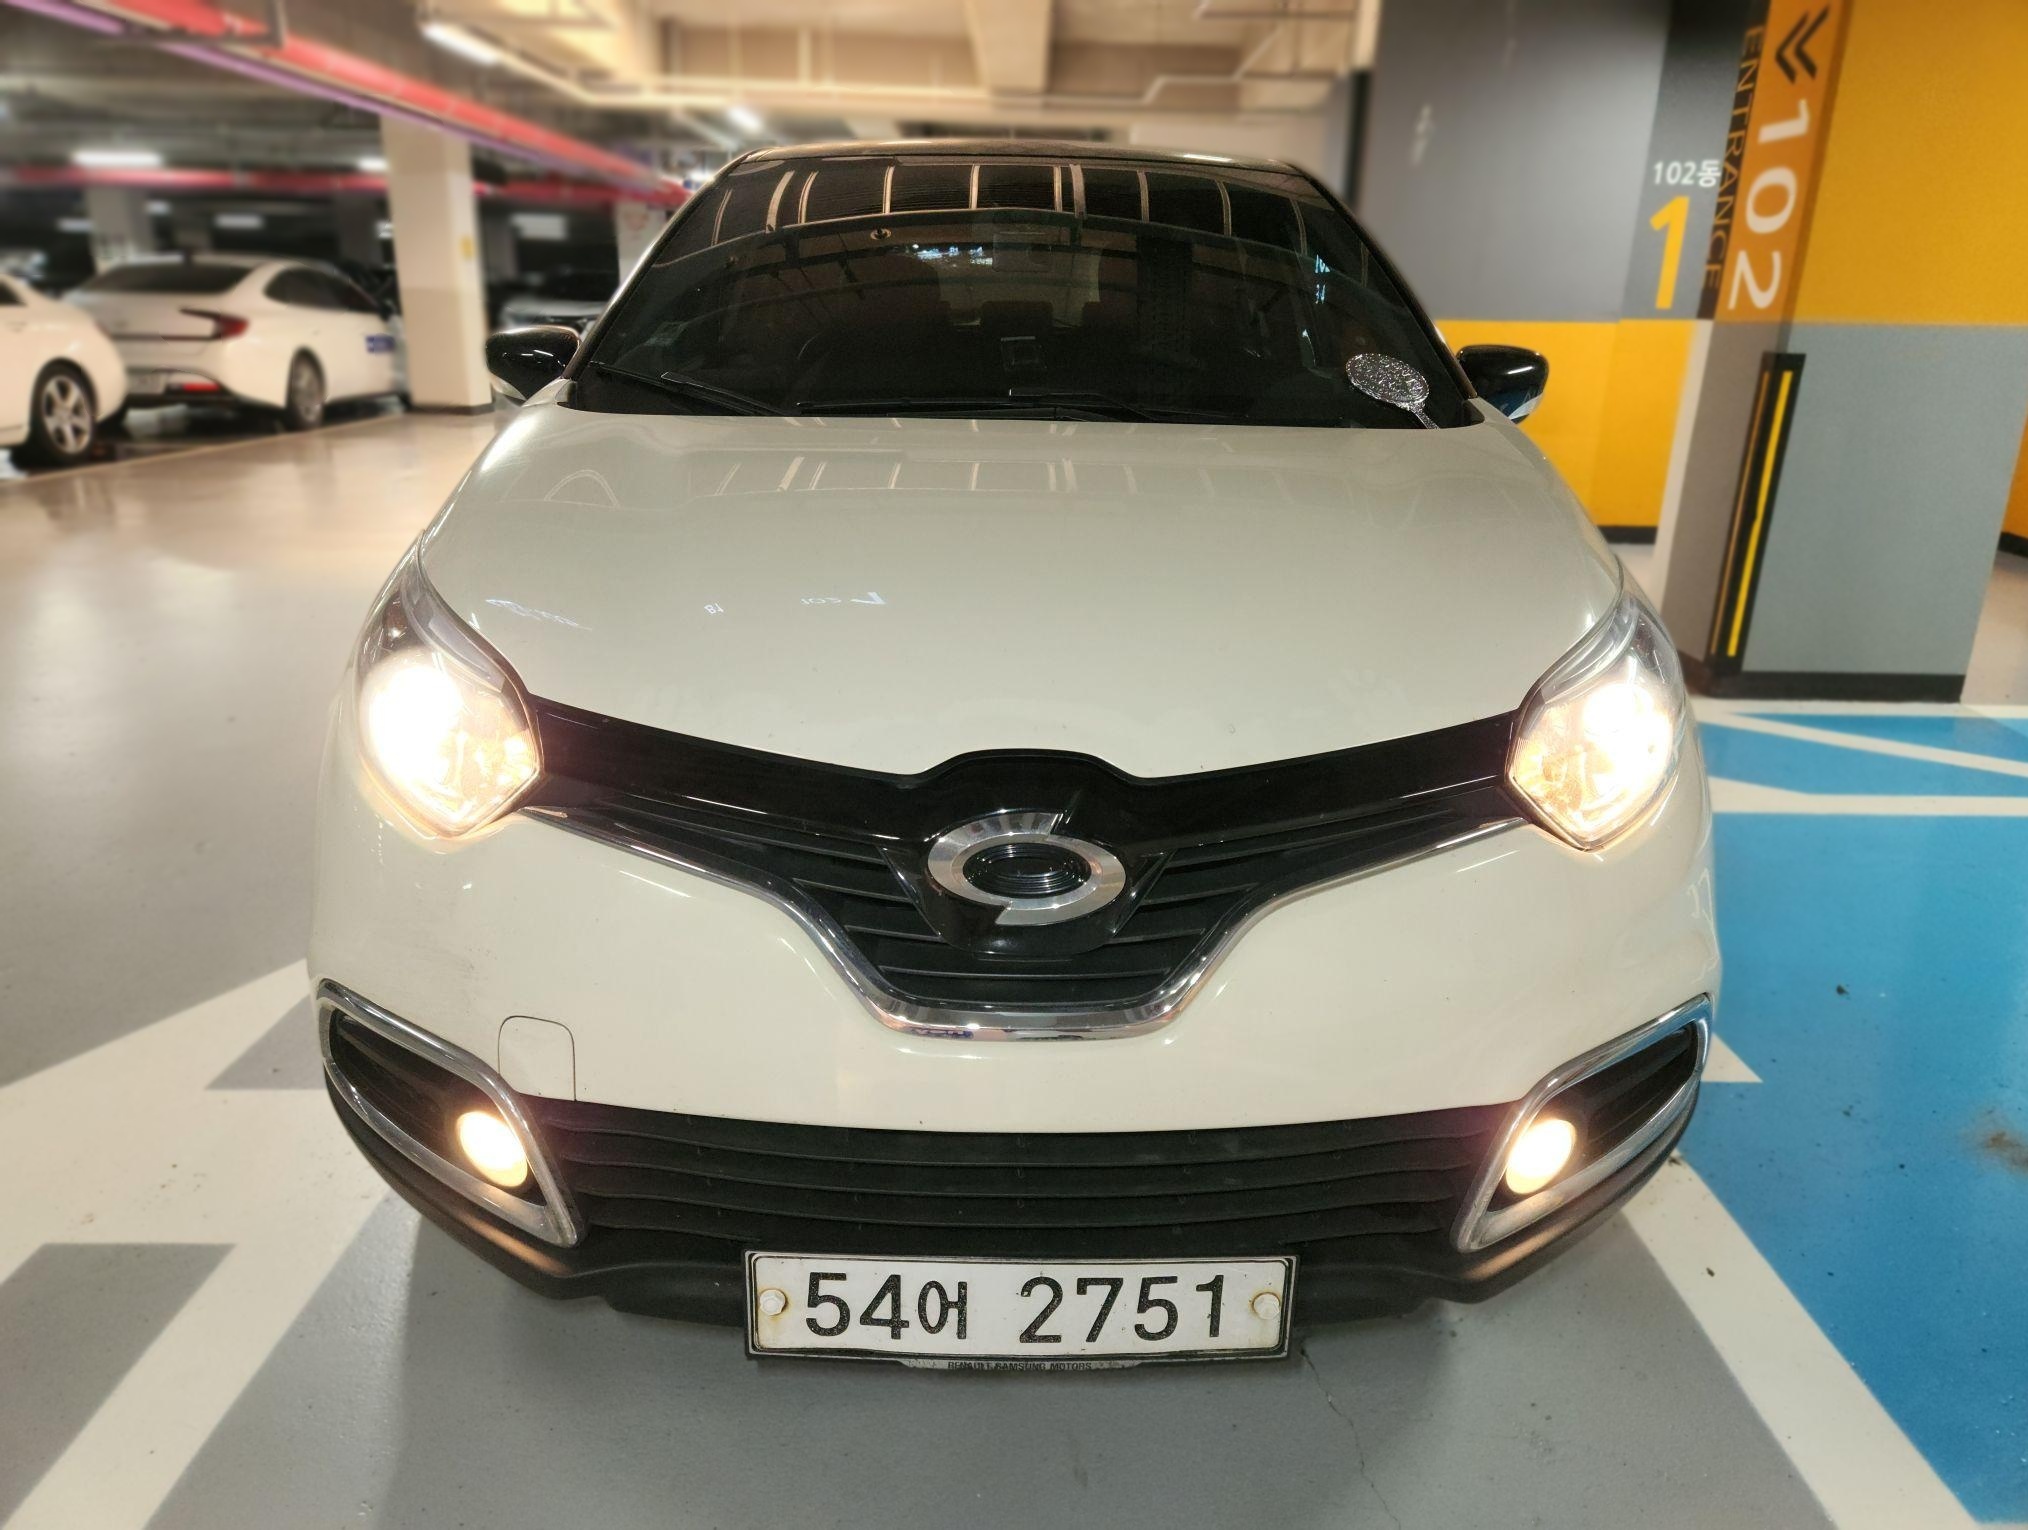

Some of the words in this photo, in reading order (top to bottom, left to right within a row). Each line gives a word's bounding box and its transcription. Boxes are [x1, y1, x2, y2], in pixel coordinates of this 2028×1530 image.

[1653, 159, 1723, 188] 102동
[1704, 25, 1765, 289] ENTRANCE
[1728, 98, 1812, 311] 102
[1650, 195, 1691, 310] 1
[805, 1272, 969, 1341] 54어
[1018, 1274, 1226, 1345] 2751
[1050, 1361, 1093, 1372] MOTORS
